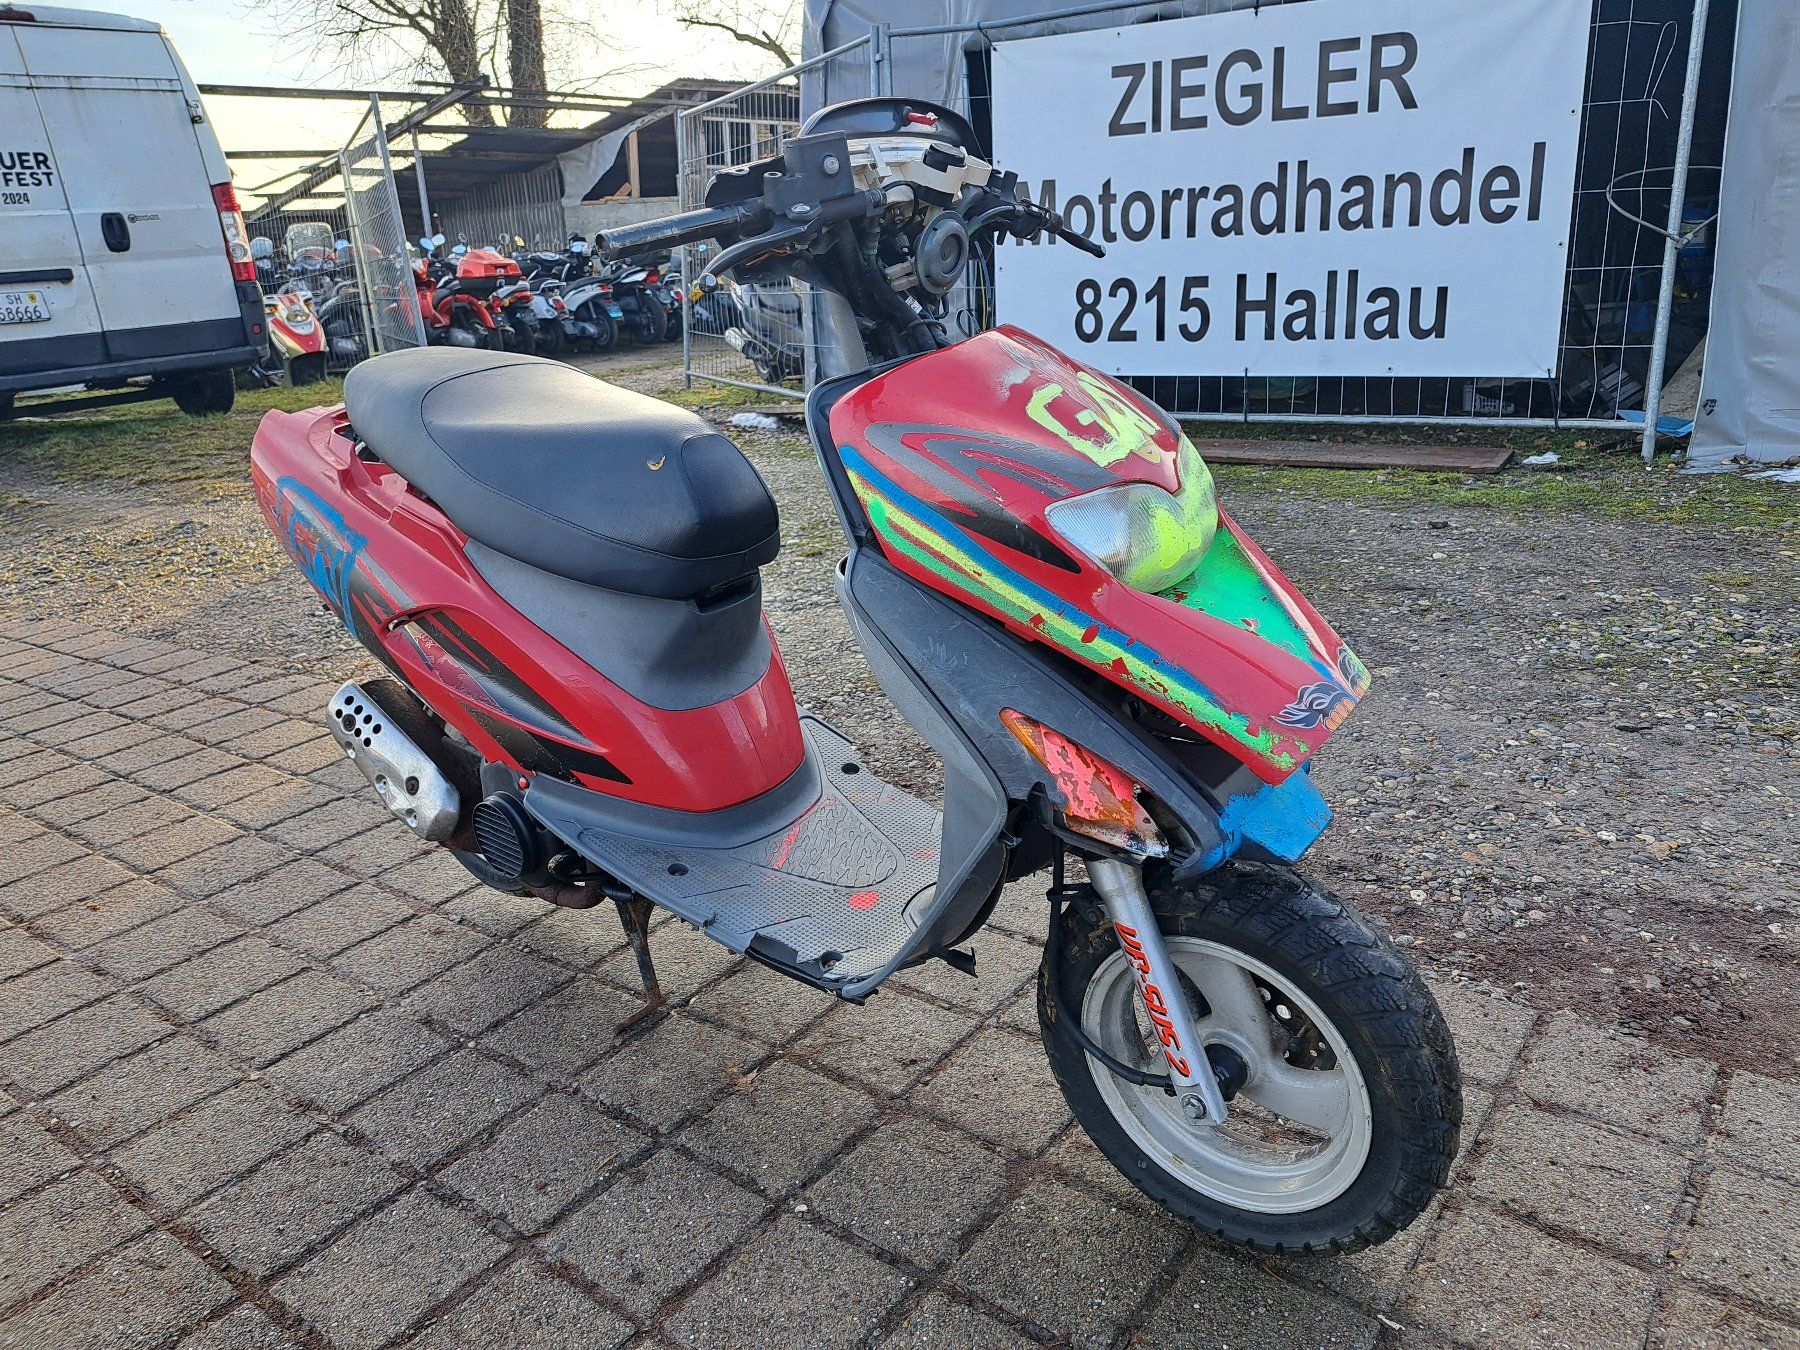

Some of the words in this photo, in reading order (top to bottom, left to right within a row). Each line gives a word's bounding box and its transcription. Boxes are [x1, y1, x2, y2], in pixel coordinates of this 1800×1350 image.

[1108, 31, 1418, 137] ZIEGLER
[0, 151, 52, 170] UER
[0, 171, 54, 187] FEST
[1, 192, 31, 205] 2024
[1015, 141, 1547, 246] Motorradhandel
[6, 294, 23, 305] SH
[1074, 275, 1211, 343] 8215
[1234, 269, 1449, 342] Hallau
[1164, 1049, 1190, 1078] 2
